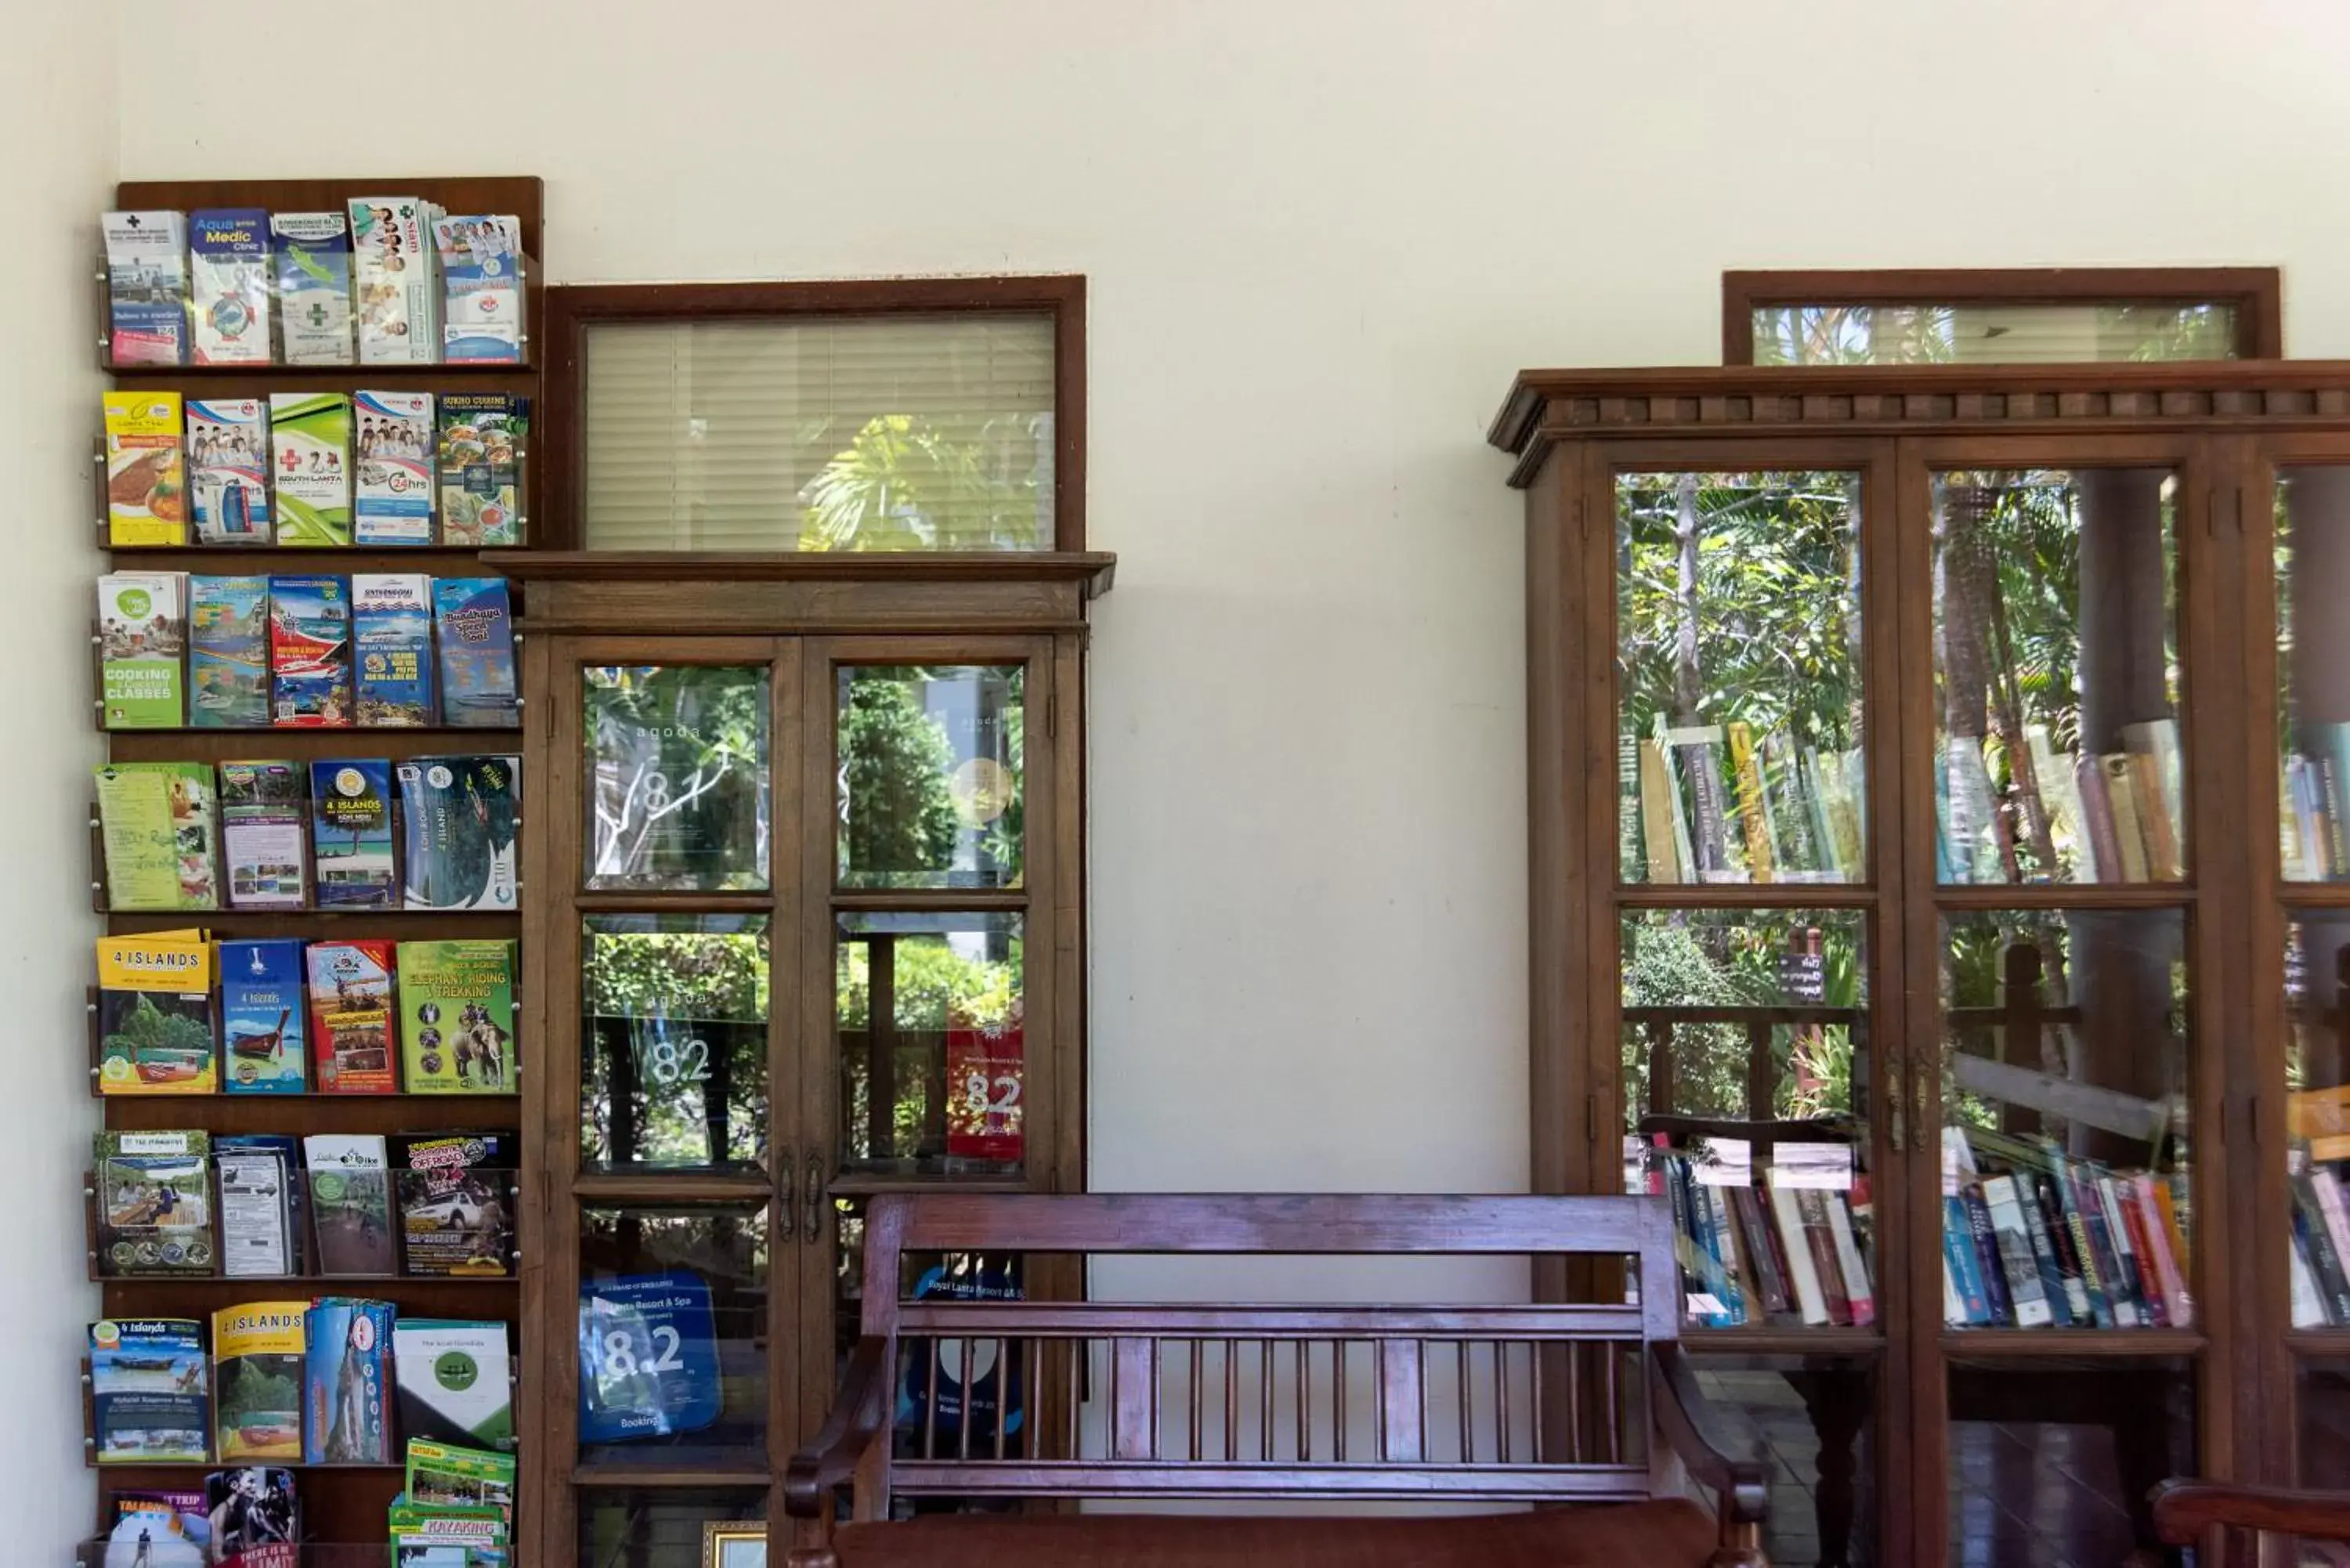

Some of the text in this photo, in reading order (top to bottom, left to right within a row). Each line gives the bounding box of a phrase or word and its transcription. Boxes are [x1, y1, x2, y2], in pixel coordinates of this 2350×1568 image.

[195, 219, 235, 230] Aqua
[205, 231, 251, 244] Medic
[233, 243, 259, 251] Clinic
[106, 668, 171, 679] COOKING
[107, 688, 172, 699] CLASSES
[326, 800, 381, 810] 4 ISLANDS
[114, 952, 198, 966] 4 ISLANDS
[438, 987, 491, 997] TREKKING
[635, 1299, 664, 1309] Resort
[674, 1296, 692, 1308] Spa
[130, 1321, 166, 1333] Islands
[233, 1314, 302, 1331] ISLANDS
[428, 1521, 495, 1535] KAYAKING
